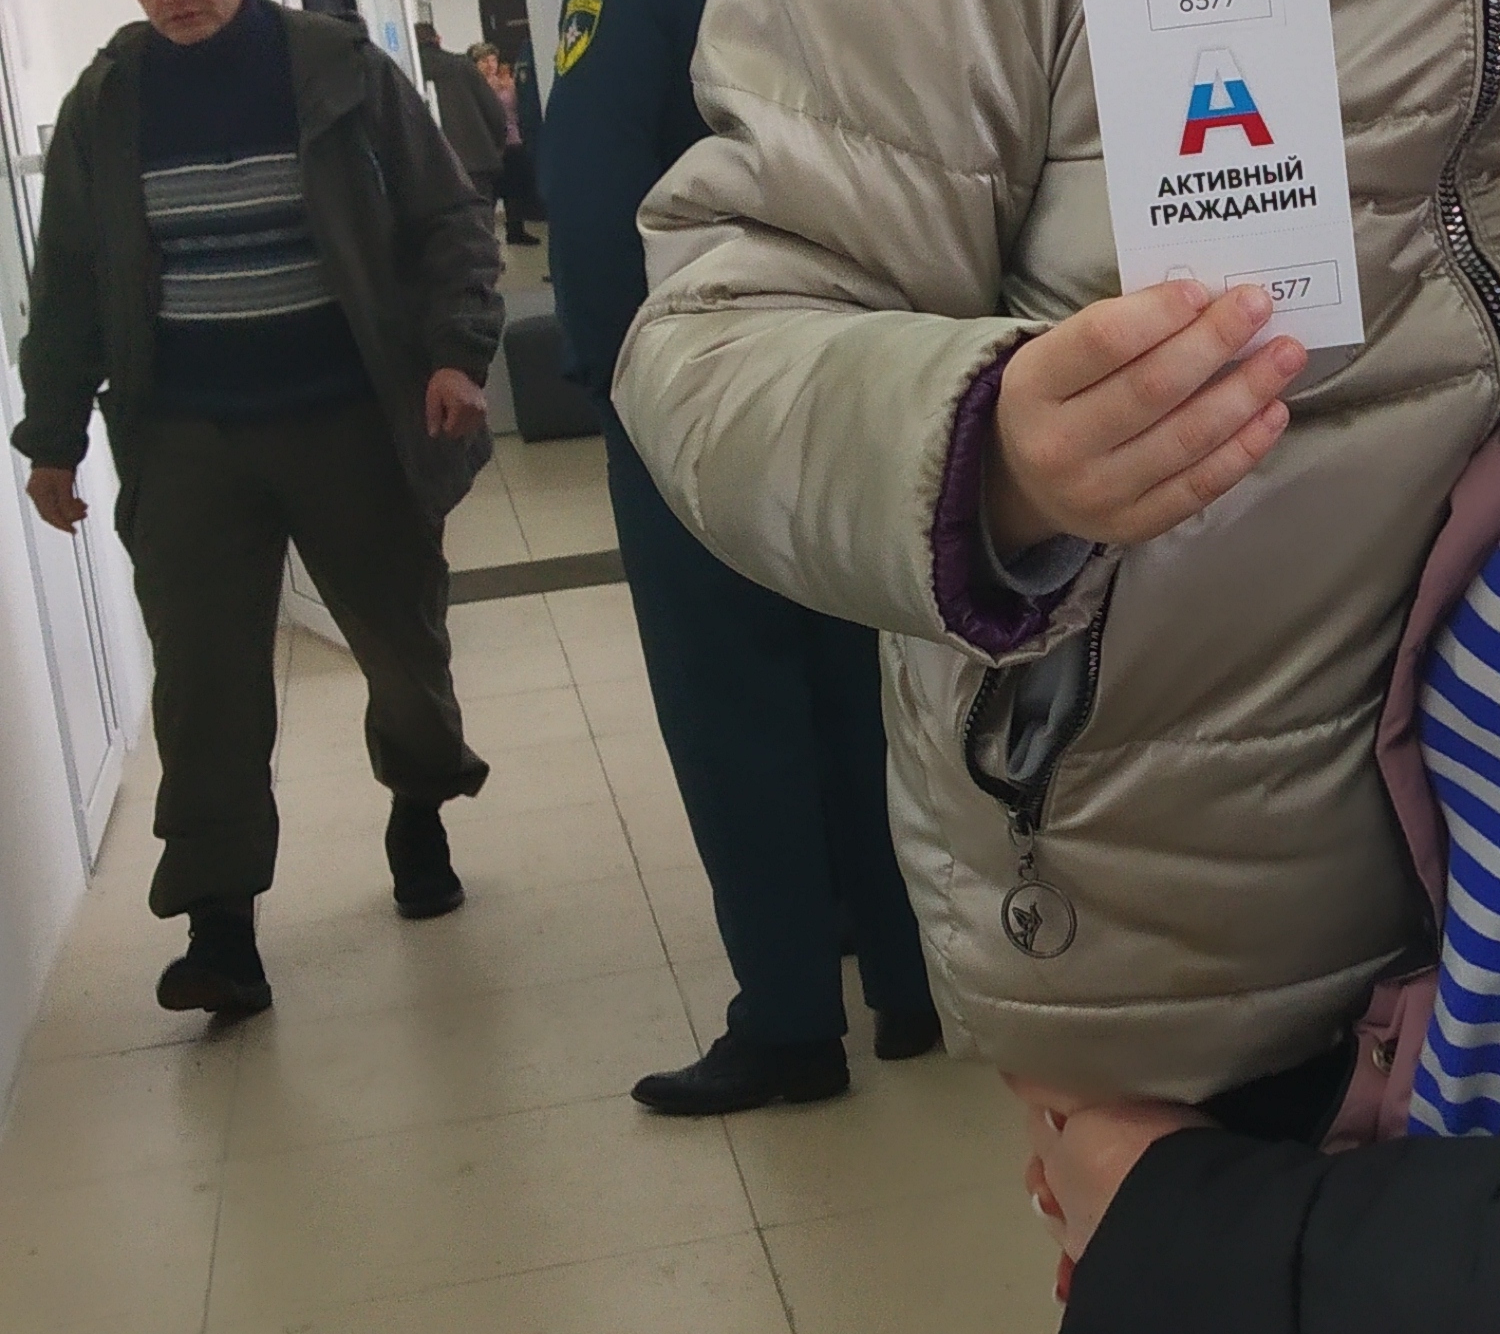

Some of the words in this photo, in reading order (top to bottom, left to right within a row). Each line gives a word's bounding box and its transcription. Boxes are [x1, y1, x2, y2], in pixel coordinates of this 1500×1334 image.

[1157, 154, 1304, 198] АКТИВНЫЙ
[1149, 185, 1318, 227] ГРАЖДАНИН
[1262, 276, 1312, 302] 577
